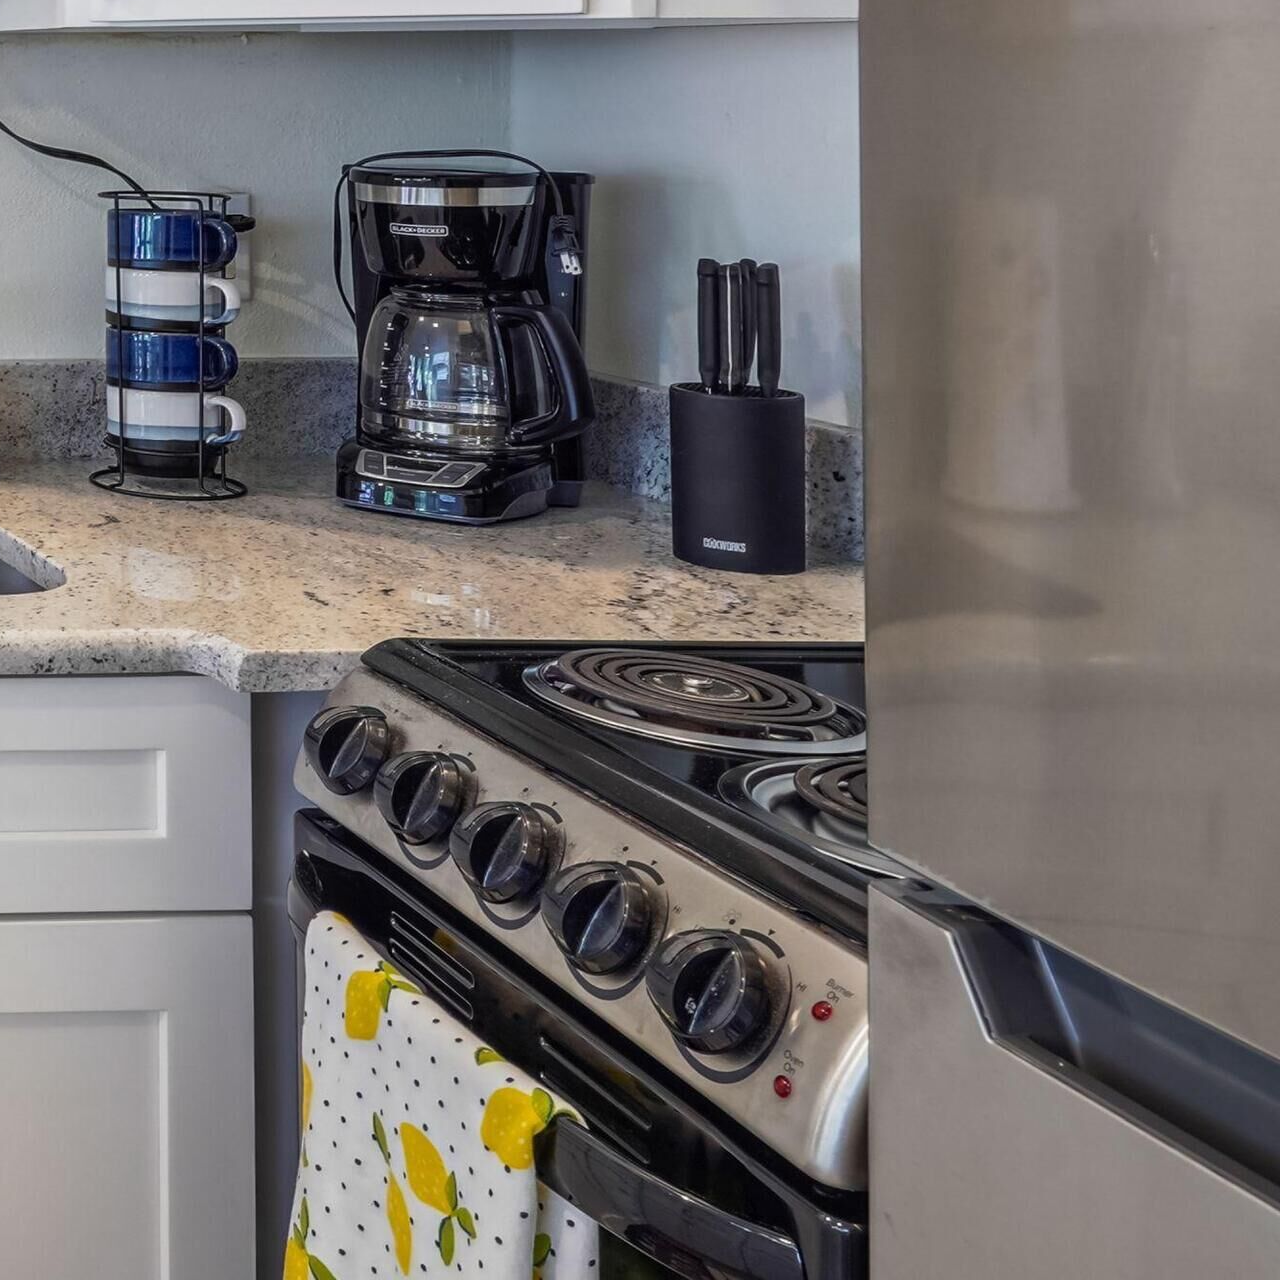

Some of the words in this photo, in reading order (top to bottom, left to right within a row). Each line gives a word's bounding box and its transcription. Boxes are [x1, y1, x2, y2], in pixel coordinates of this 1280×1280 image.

[703, 537, 746, 553] COOKWORKS
[825, 977, 855, 999] Burner
[826, 990, 841, 1004] On
[783, 1049, 805, 1070] Oven
[783, 1062, 796, 1076] On
